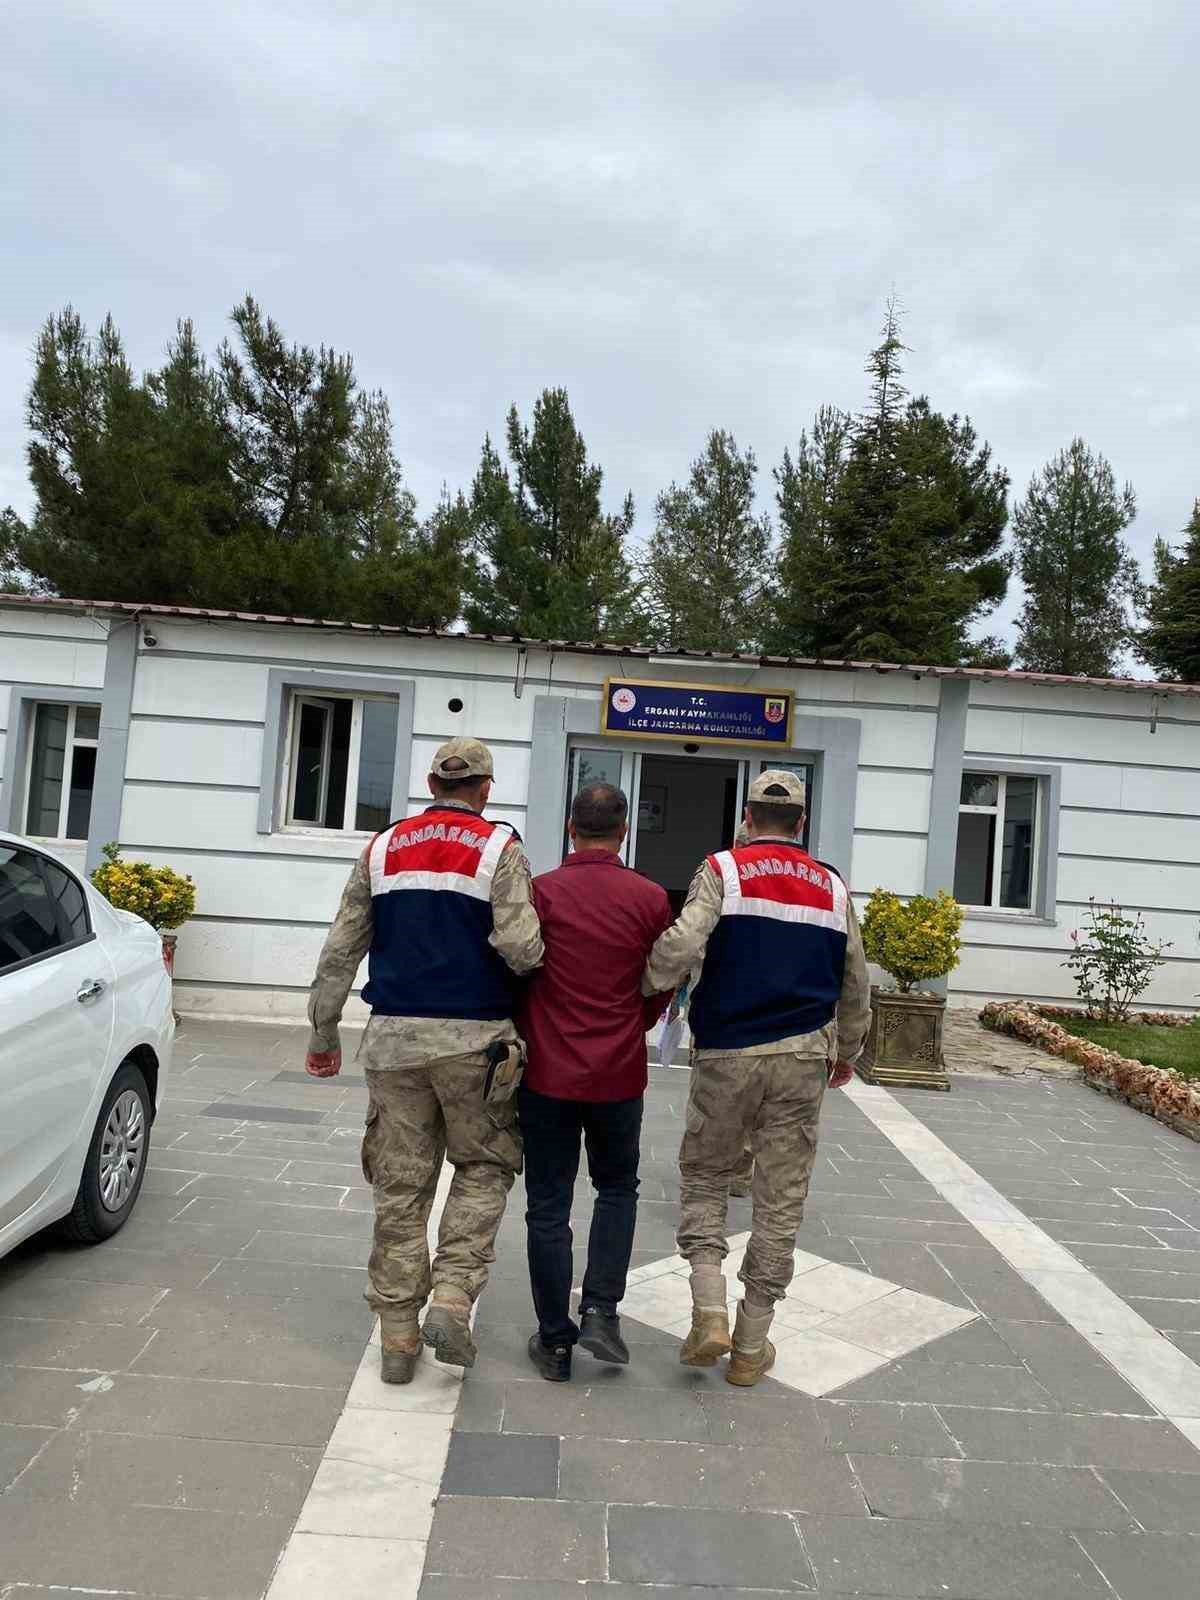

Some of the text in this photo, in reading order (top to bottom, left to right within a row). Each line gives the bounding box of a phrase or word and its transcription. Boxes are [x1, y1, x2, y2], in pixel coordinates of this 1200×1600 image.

[690, 697, 708, 706] T.C.
[645, 706, 679, 717] ERGANİ
[628, 717, 648, 728] İLÇE
[651, 719, 701, 731] JANDARMA
[388, 823, 488, 853] JANDARMA
[740, 858, 833, 894] JANDARMA
